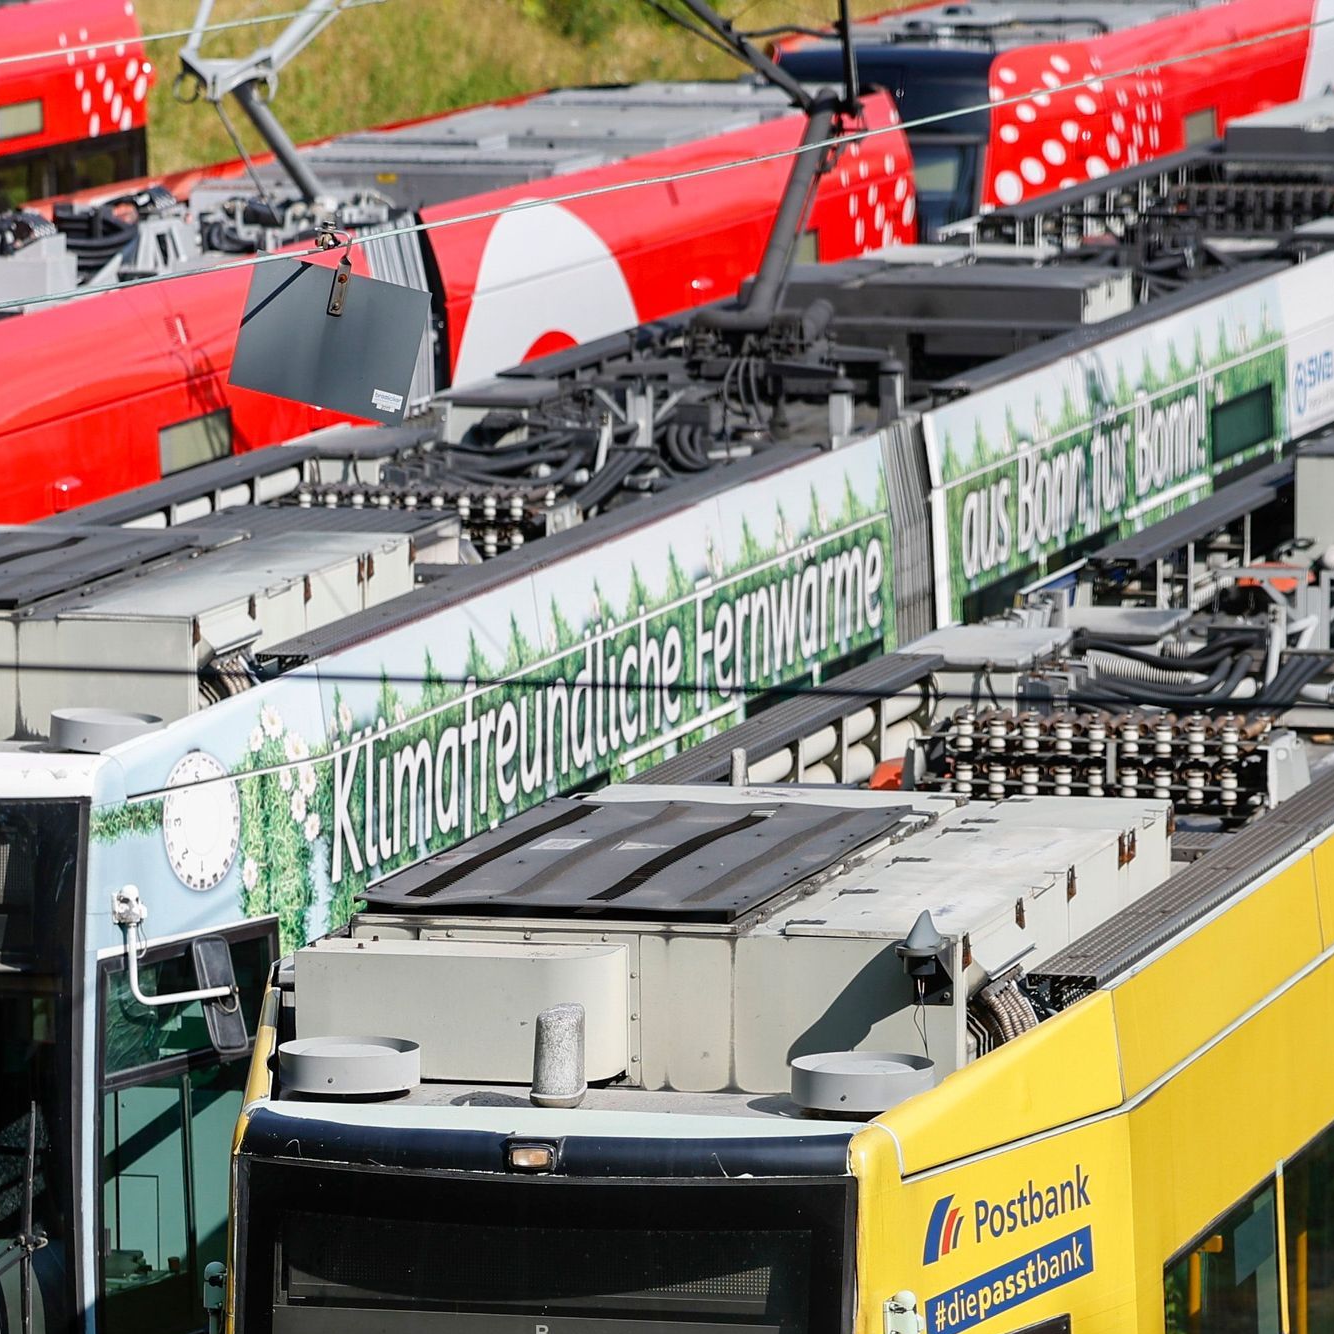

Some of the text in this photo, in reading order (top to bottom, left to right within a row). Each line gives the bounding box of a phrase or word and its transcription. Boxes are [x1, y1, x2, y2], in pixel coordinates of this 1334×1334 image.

[962, 477, 1012, 580] aus
[1134, 366, 1207, 497] Bonn!
[331, 535, 884, 883] Klimafreundliche Fernwärme
[974, 1164, 1091, 1244] Postbank
[935, 1236, 1085, 1334] #diepasstbank
